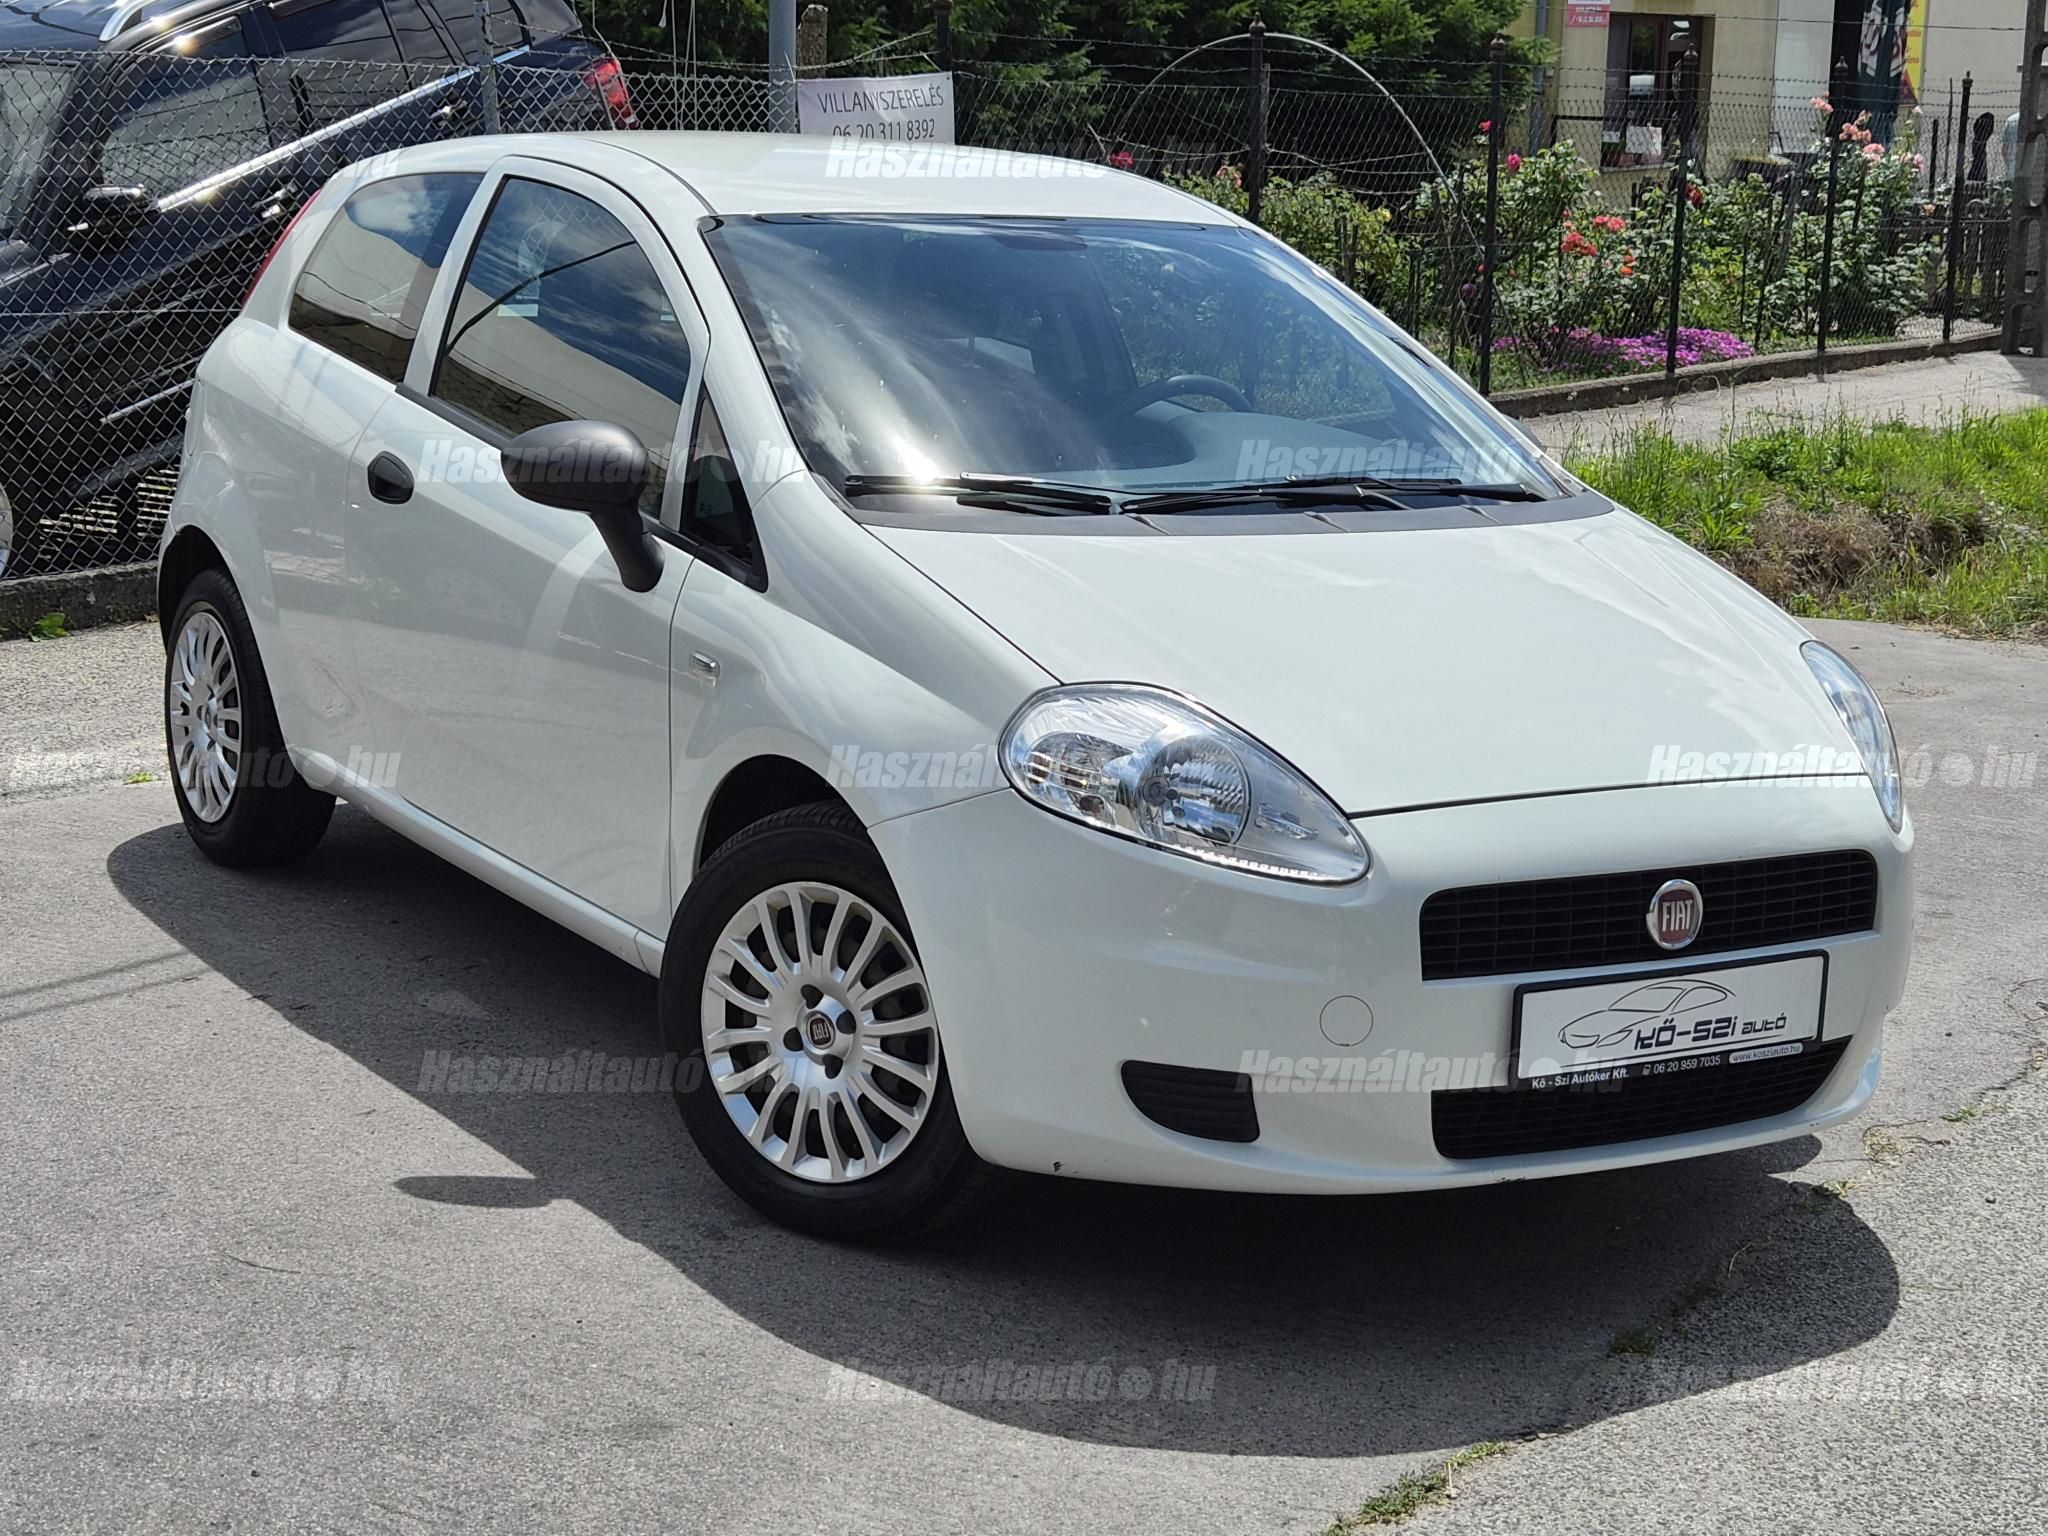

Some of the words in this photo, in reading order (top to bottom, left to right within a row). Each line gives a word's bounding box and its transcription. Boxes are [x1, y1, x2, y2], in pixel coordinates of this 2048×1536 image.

[817, 83, 944, 114] VILLANYSZERELÉS
[879, 122, 900, 141] 311
[906, 118, 935, 141] 8392
[1662, 899, 1693, 932] FIAT
[1653, 1063, 1665, 1074] 06
[1667, 1061, 1679, 1073] 20
[1681, 1058, 1698, 1071] 959
[1700, 1055, 1721, 1068] 7035
[1571, 1070, 1610, 1085] Autóker
